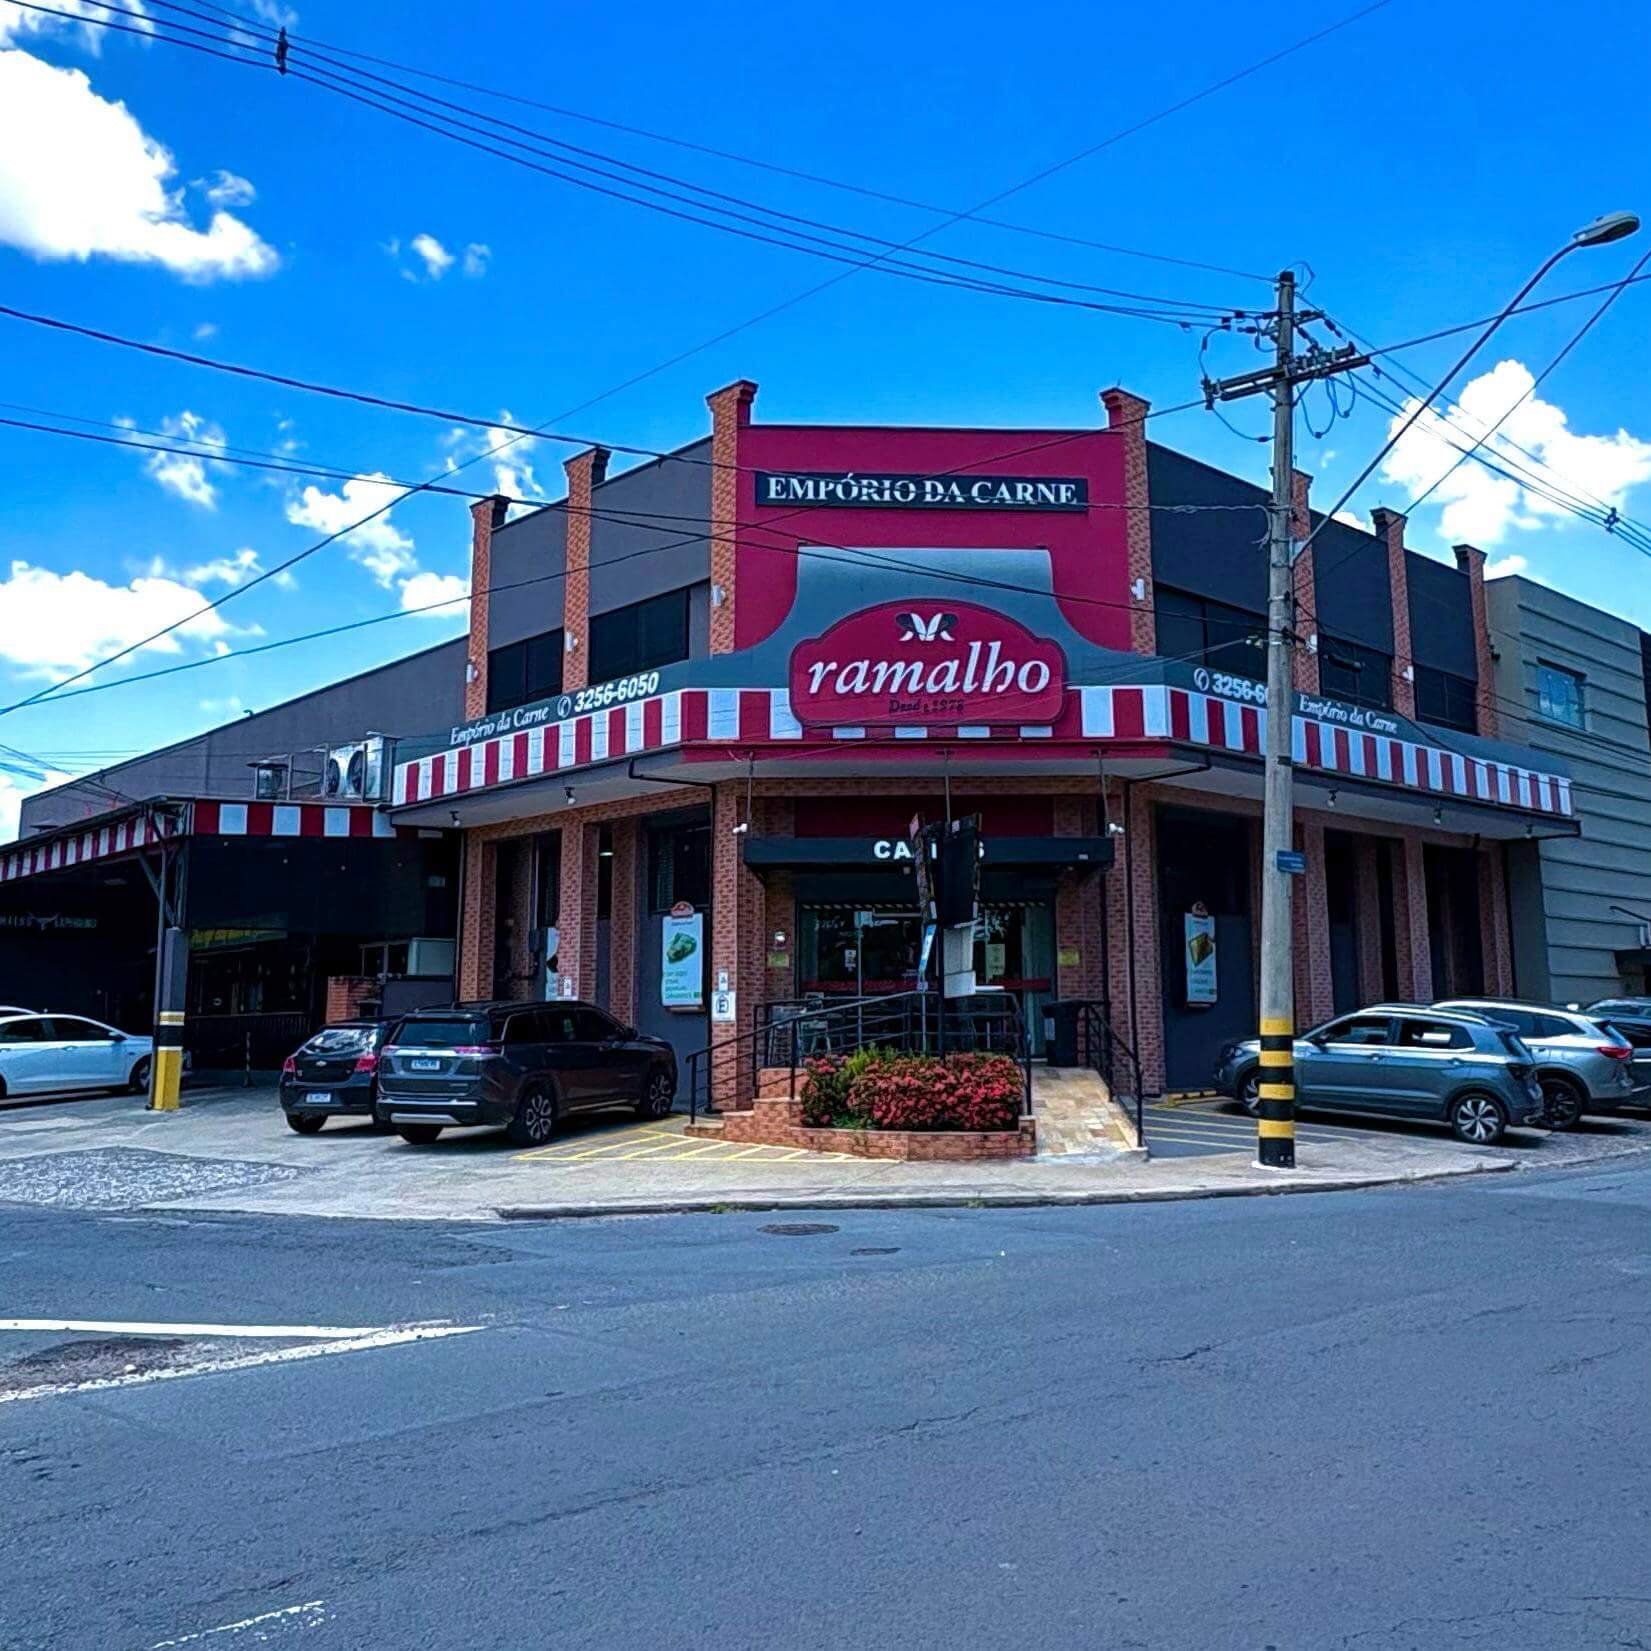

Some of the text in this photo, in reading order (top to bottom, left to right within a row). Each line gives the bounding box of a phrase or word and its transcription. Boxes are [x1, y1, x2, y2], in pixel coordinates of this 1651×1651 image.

[767, 472, 1079, 506] EMPÓRIO DA CARNE
[808, 641, 1051, 695] ramalho
[449, 671, 660, 747] Empório da Carne 3256-6050
[1300, 693, 1347, 722] Empório
[1349, 706, 1364, 727] da
[1365, 711, 1398, 734] Carne
